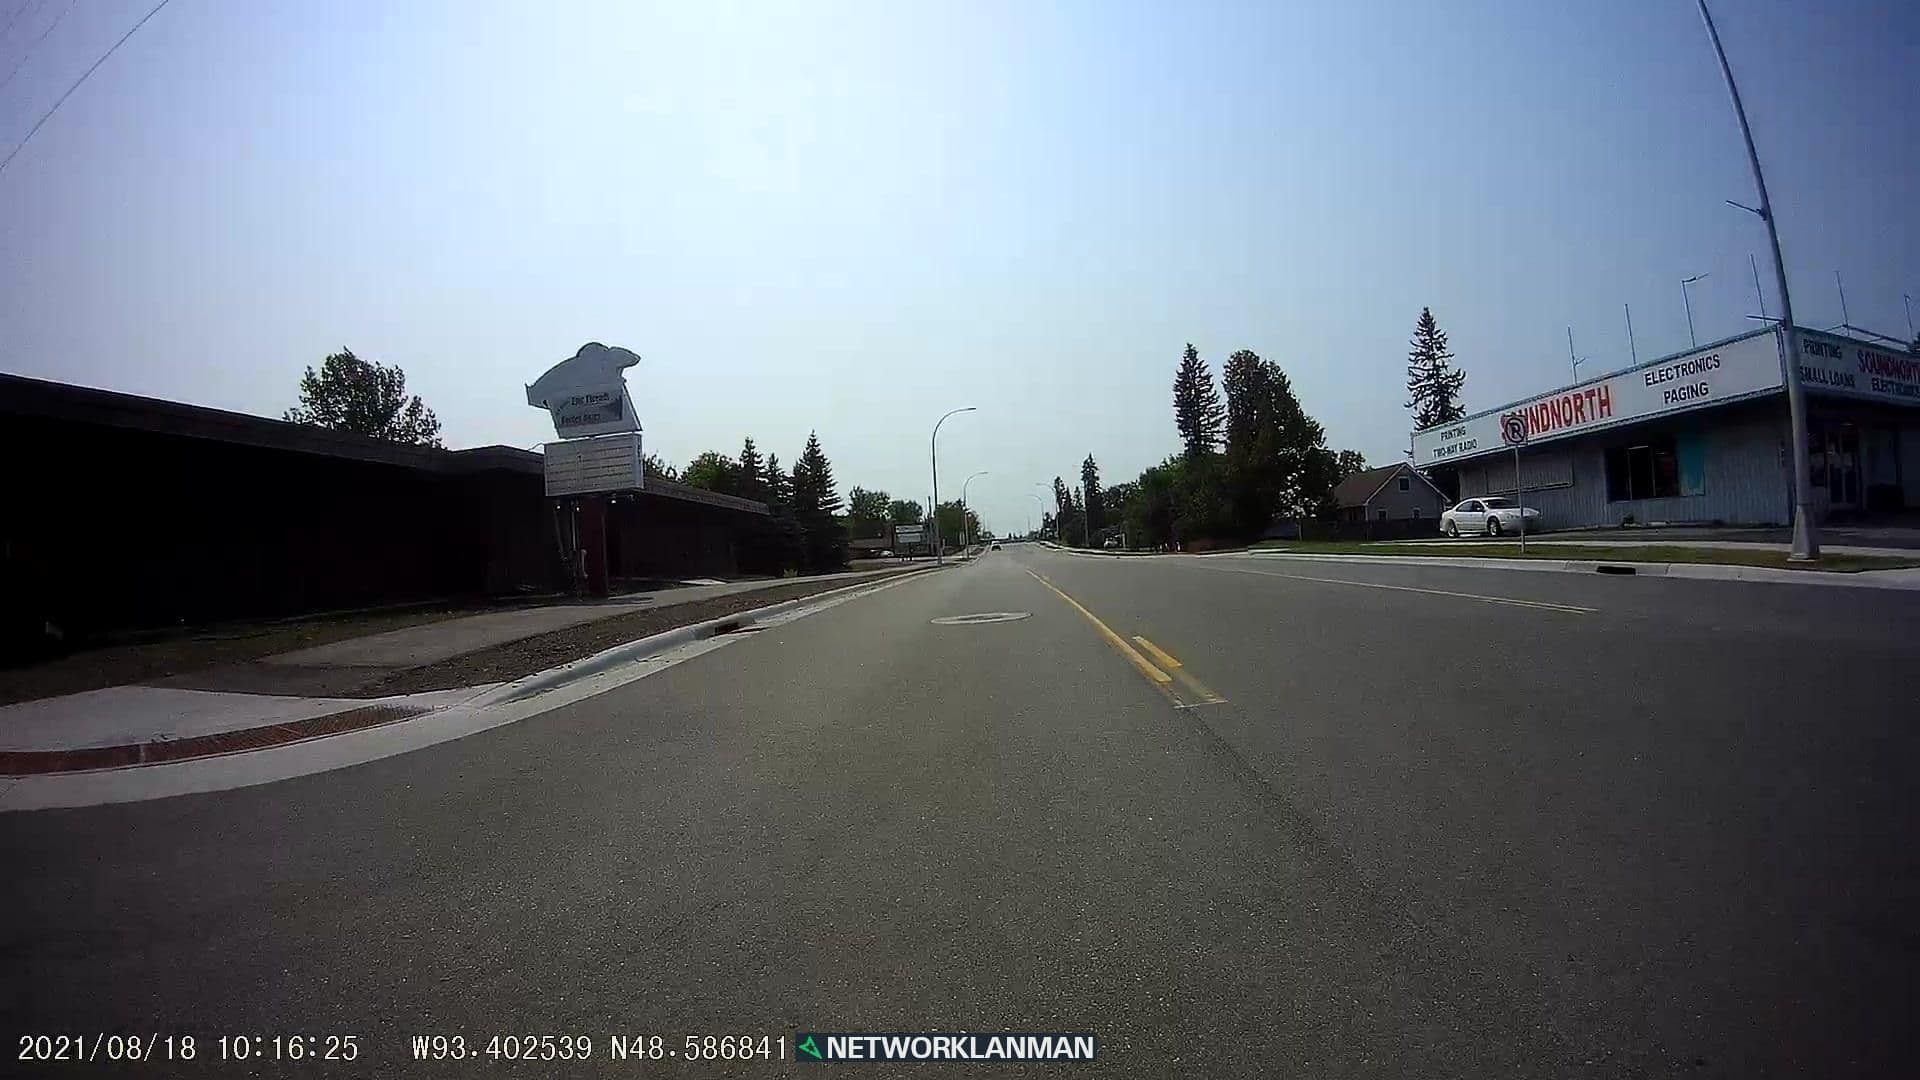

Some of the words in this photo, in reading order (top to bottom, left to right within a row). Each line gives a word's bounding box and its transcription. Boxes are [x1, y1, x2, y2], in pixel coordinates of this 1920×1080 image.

[1803, 339, 1843, 360] PRINTING
[1645, 354, 1720, 387] ELECTRONICS
[1663, 382, 1709, 404] PAGING
[1500, 384, 1612, 439] NDNORTH
